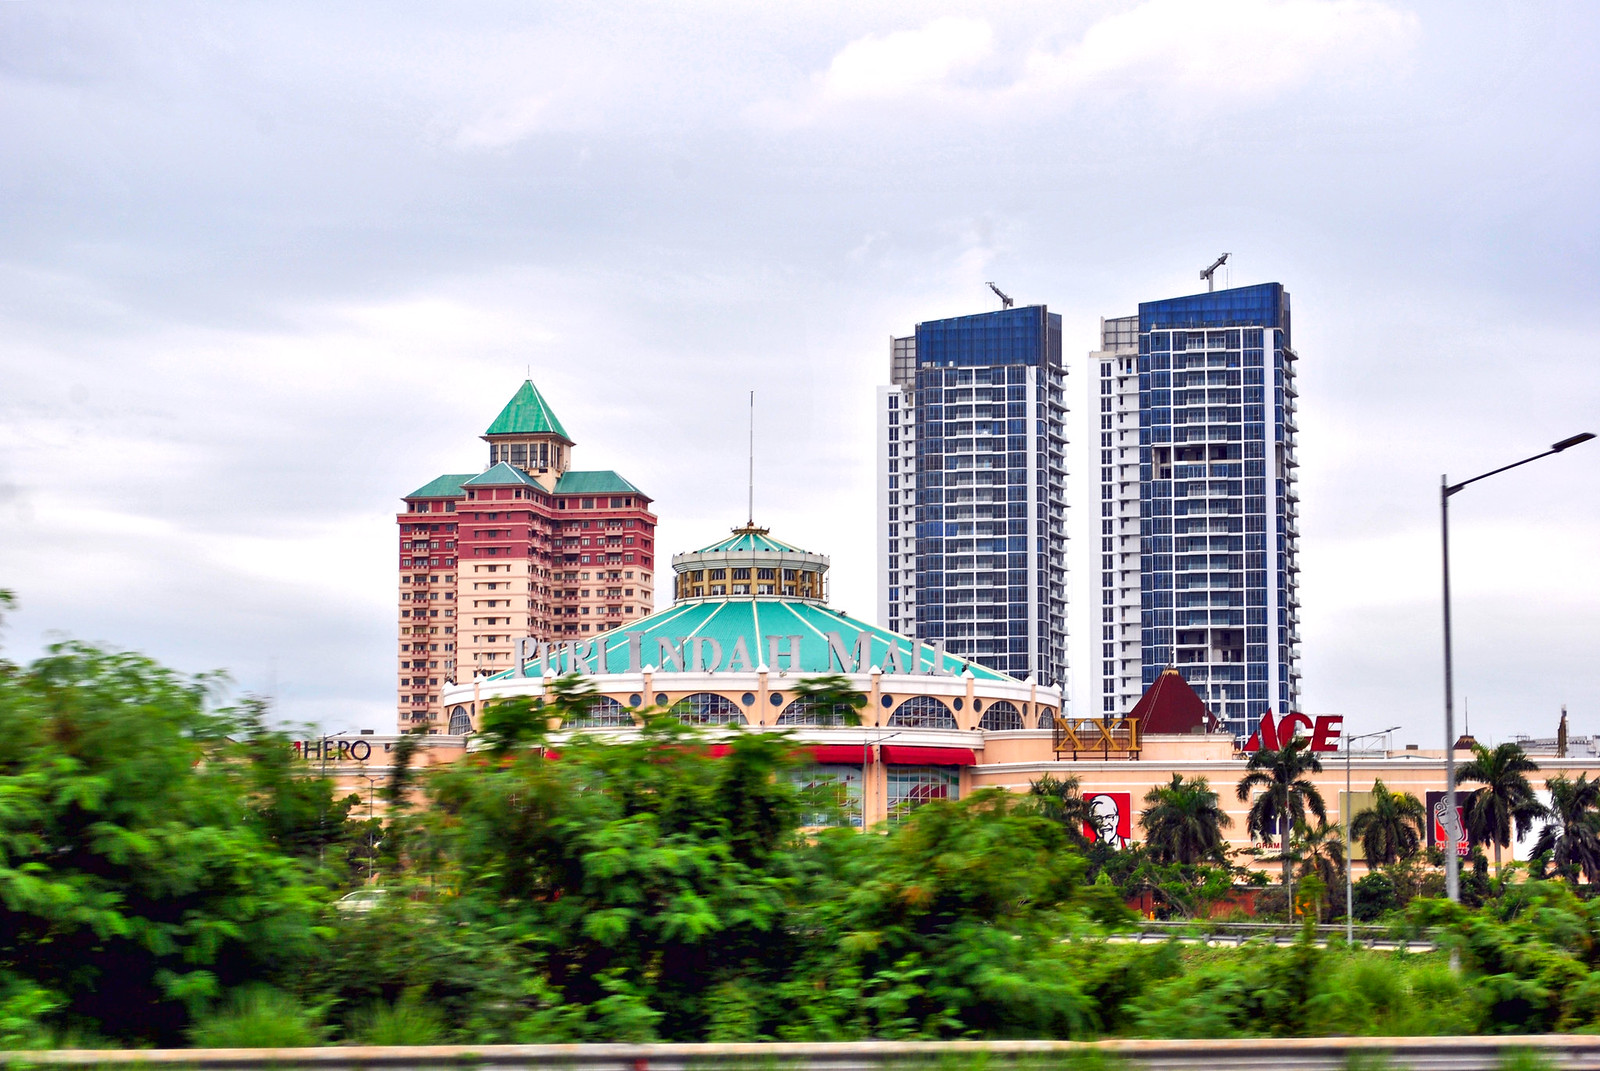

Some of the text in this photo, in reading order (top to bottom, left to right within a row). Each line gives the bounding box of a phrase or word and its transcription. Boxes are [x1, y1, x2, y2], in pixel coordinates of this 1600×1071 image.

[513, 631, 955, 678] PURI INDAH MALL
[1054, 718, 1142, 751] XXI
[1242, 707, 1344, 752] ACE
[304, 740, 371, 760] HERO
